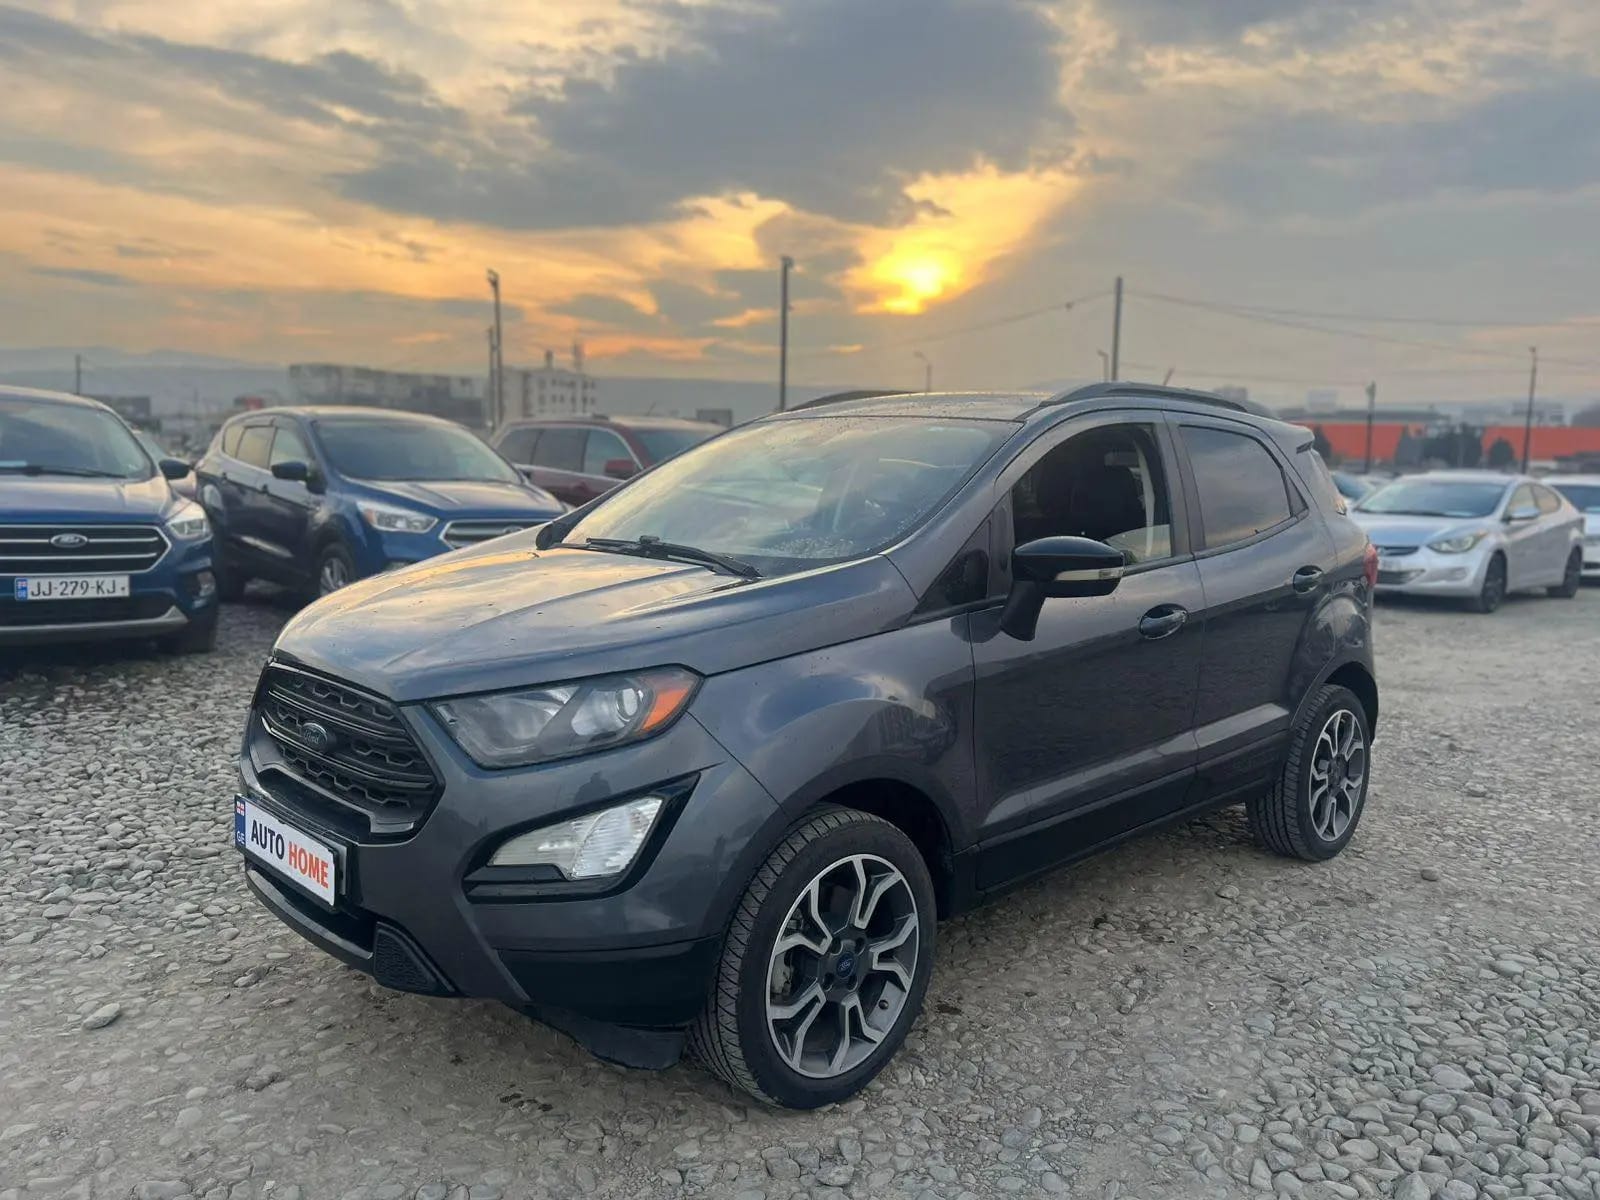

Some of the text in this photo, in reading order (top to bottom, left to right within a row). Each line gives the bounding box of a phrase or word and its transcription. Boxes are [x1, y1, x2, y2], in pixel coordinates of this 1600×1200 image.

[30, 580, 116, 597] JJ-279-KJ
[236, 831, 245, 845] GE
[251, 819, 329, 889] AUTO HOME
